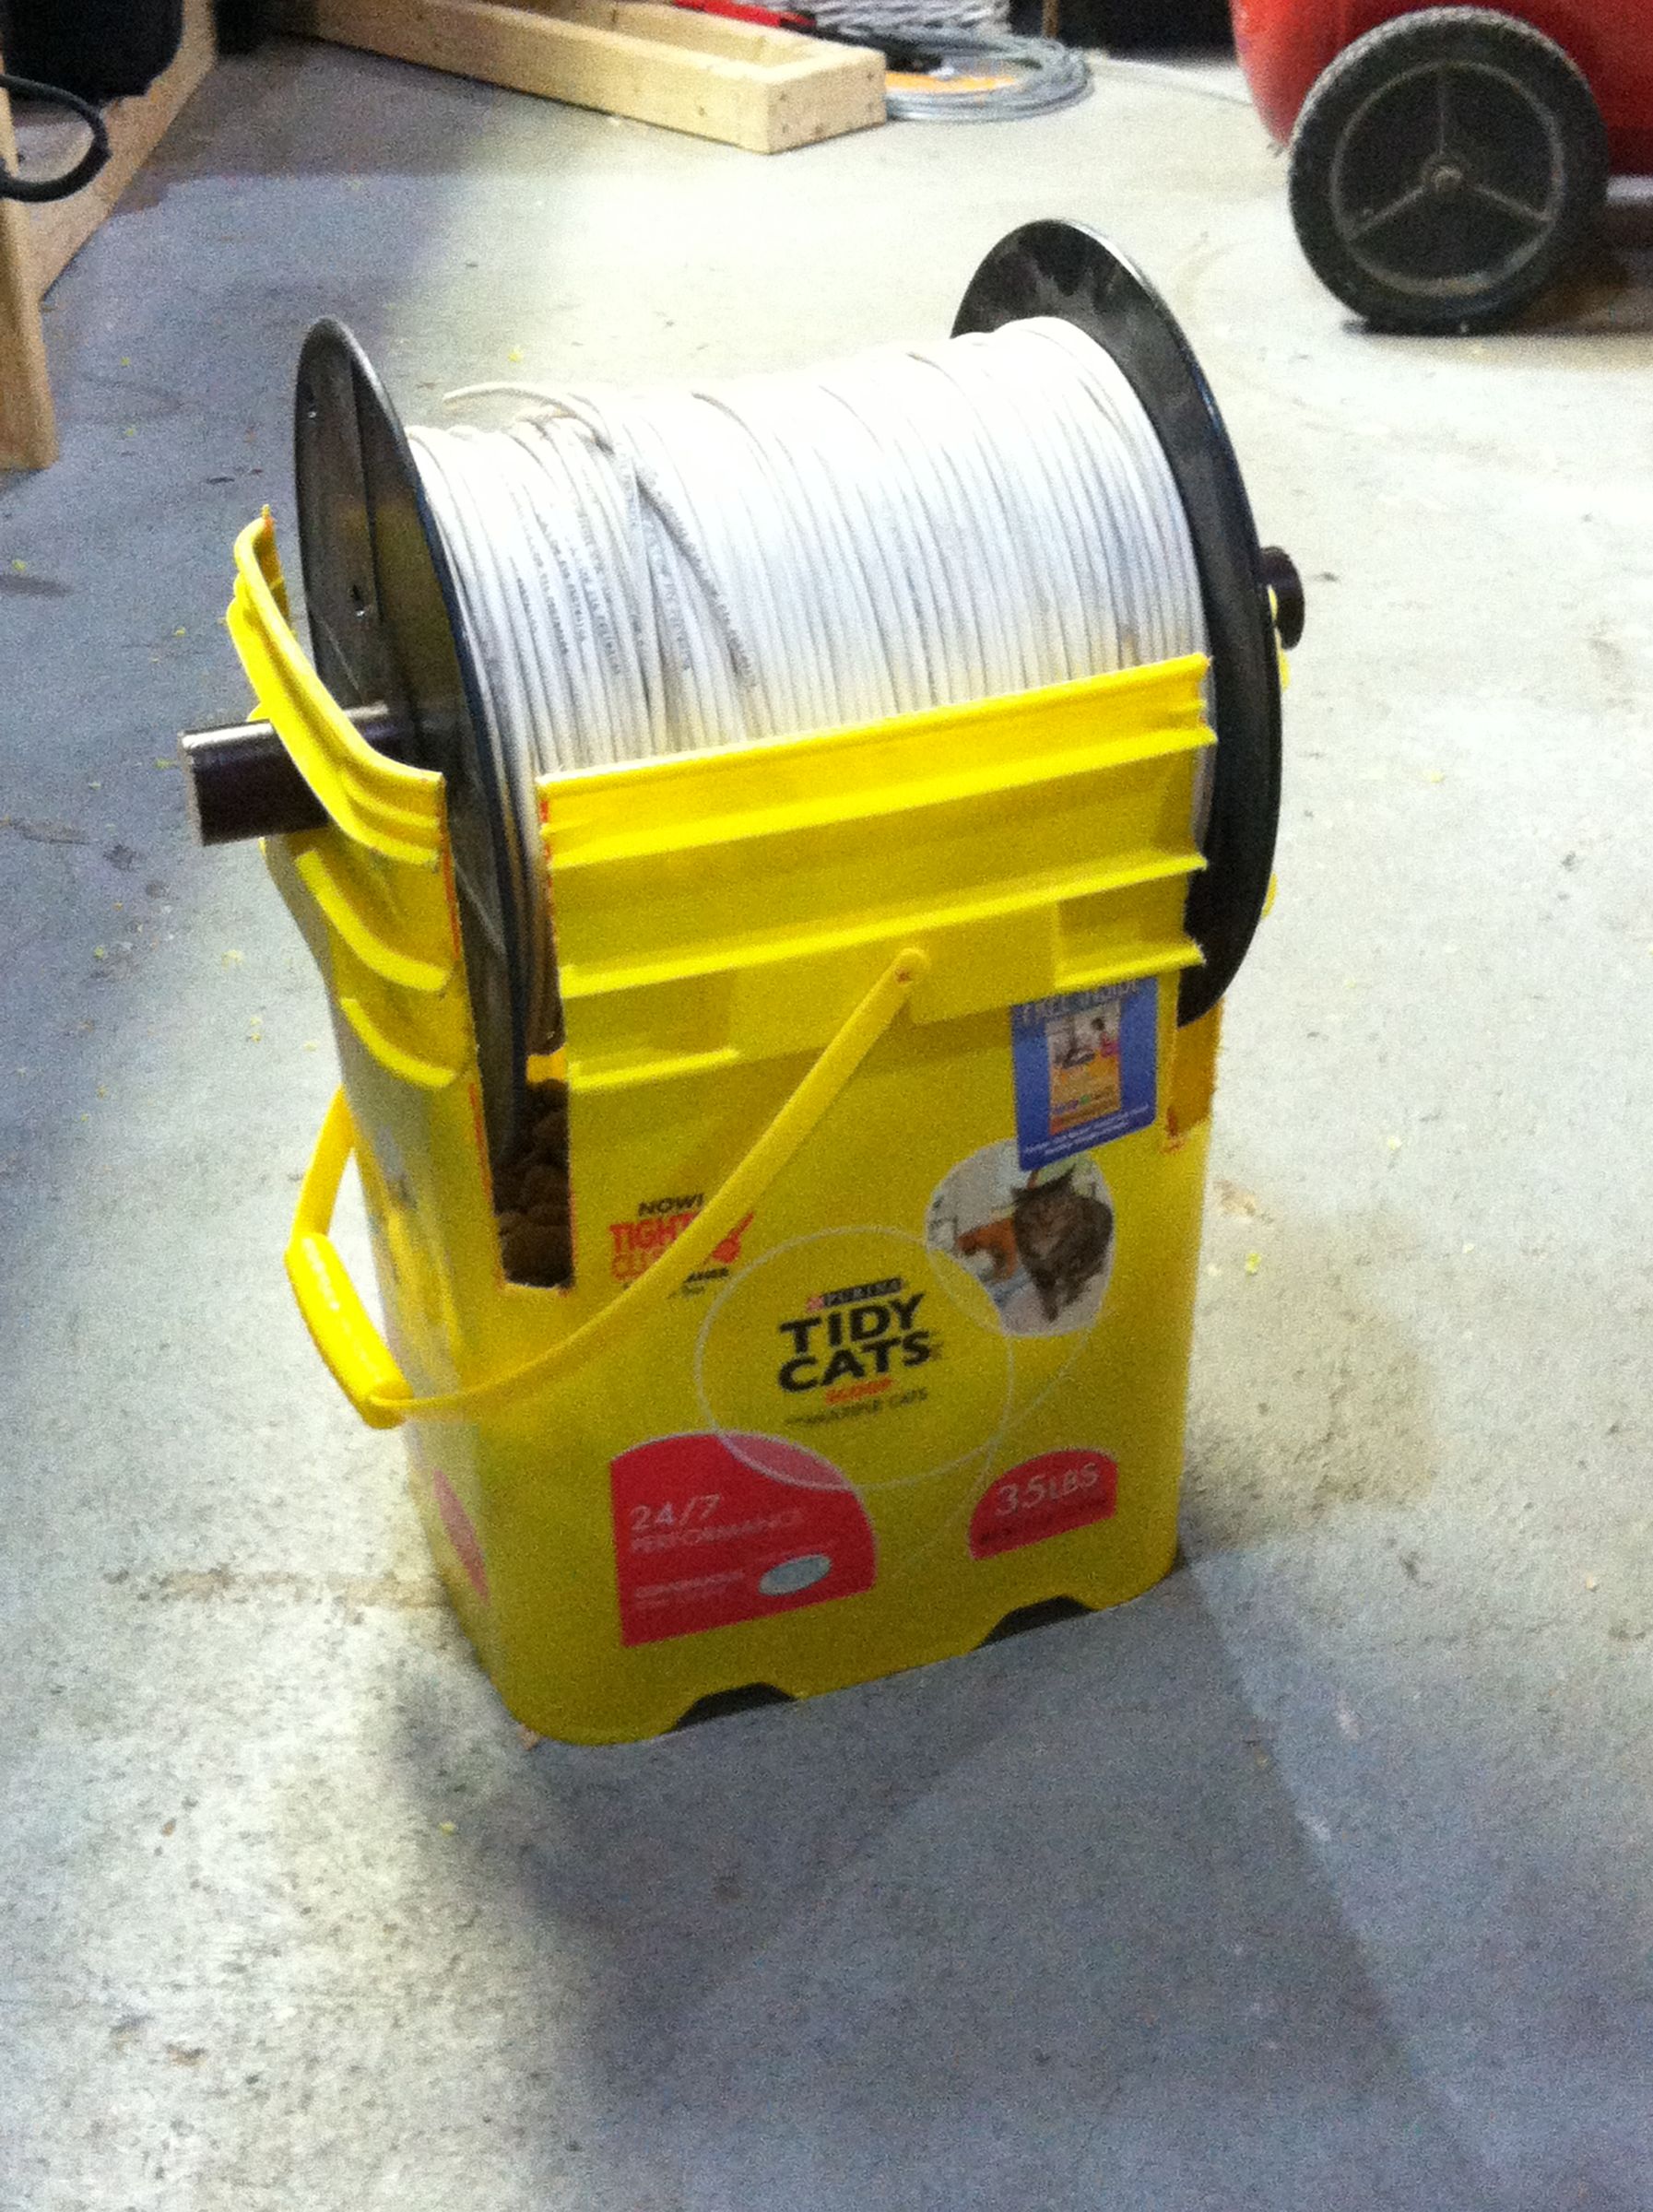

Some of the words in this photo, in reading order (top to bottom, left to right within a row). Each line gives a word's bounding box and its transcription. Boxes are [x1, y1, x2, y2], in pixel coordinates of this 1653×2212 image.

[779, 1292, 926, 1354] TIDY
[778, 1330, 930, 1394] CATS
[631, 1493, 722, 1532] 24/7
